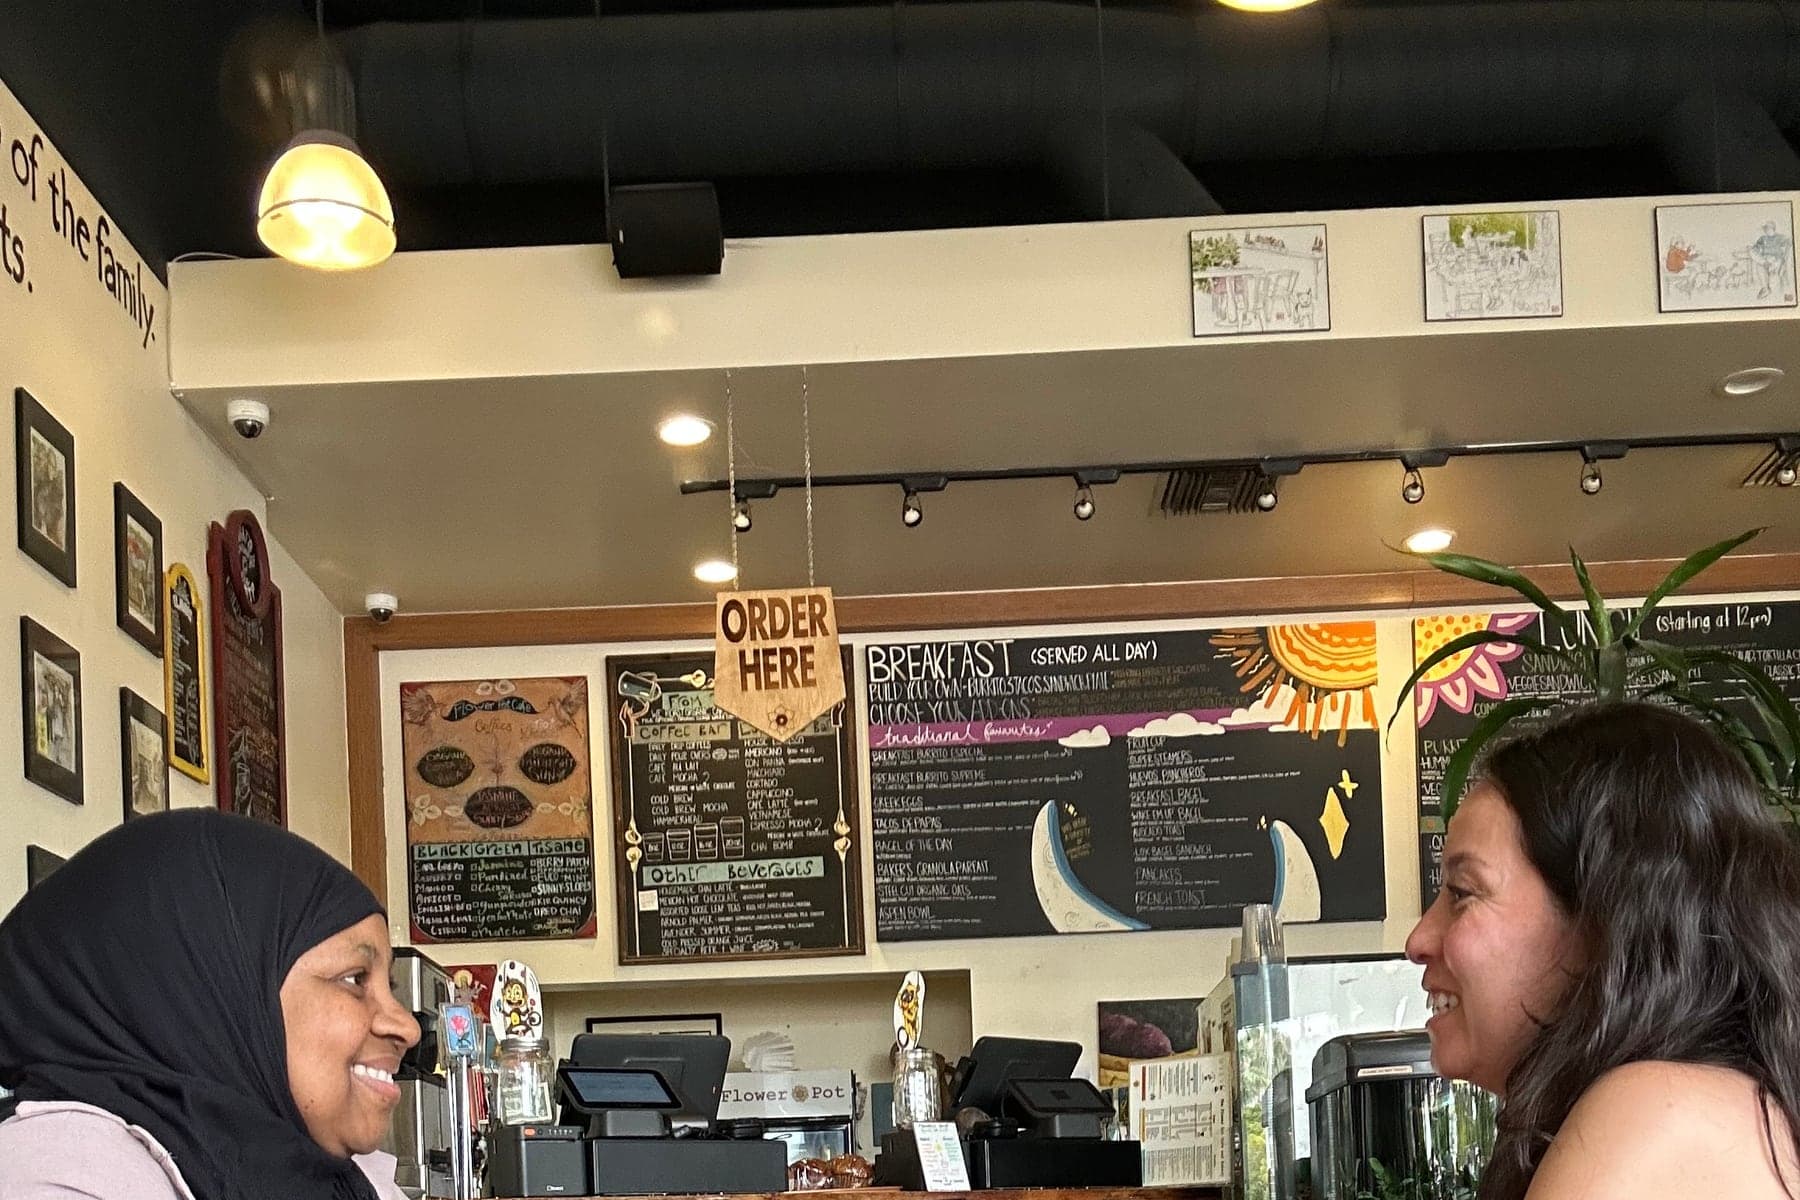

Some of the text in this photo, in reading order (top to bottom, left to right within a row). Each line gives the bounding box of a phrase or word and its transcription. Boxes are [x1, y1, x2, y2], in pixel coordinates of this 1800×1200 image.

[12, 134, 155, 349] of the family.
[721, 594, 830, 643] ORDER
[1656, 610, 1711, 634] (starting
[1715, 606, 1730, 628] at
[739, 645, 817, 692] HERE
[868, 640, 1158, 683] BREAKFAST (SERVED ALL DAY)
[869, 681, 903, 702] BUILD
[870, 701, 924, 726] CHOOSE
[650, 793, 694, 805] COLD BREW
[1177, 788, 1204, 801] BAGEL
[652, 802, 729, 815] COLD BREW MOCHA
[874, 817, 900, 829] TACOS
[914, 816, 943, 829] PAPAS
[417, 844, 470, 858] BLACK
[772, 840, 794, 851] BOMB
[875, 838, 953, 851] BAGEL OF THE DAY
[1136, 867, 1183, 881] PANCAKES
[952, 884, 972, 896] OATS
[1135, 889, 1207, 906] FRENCH TOAST
[879, 905, 936, 920] ASPEN BOWL
[721, 1085, 846, 1103] Flower Pot
